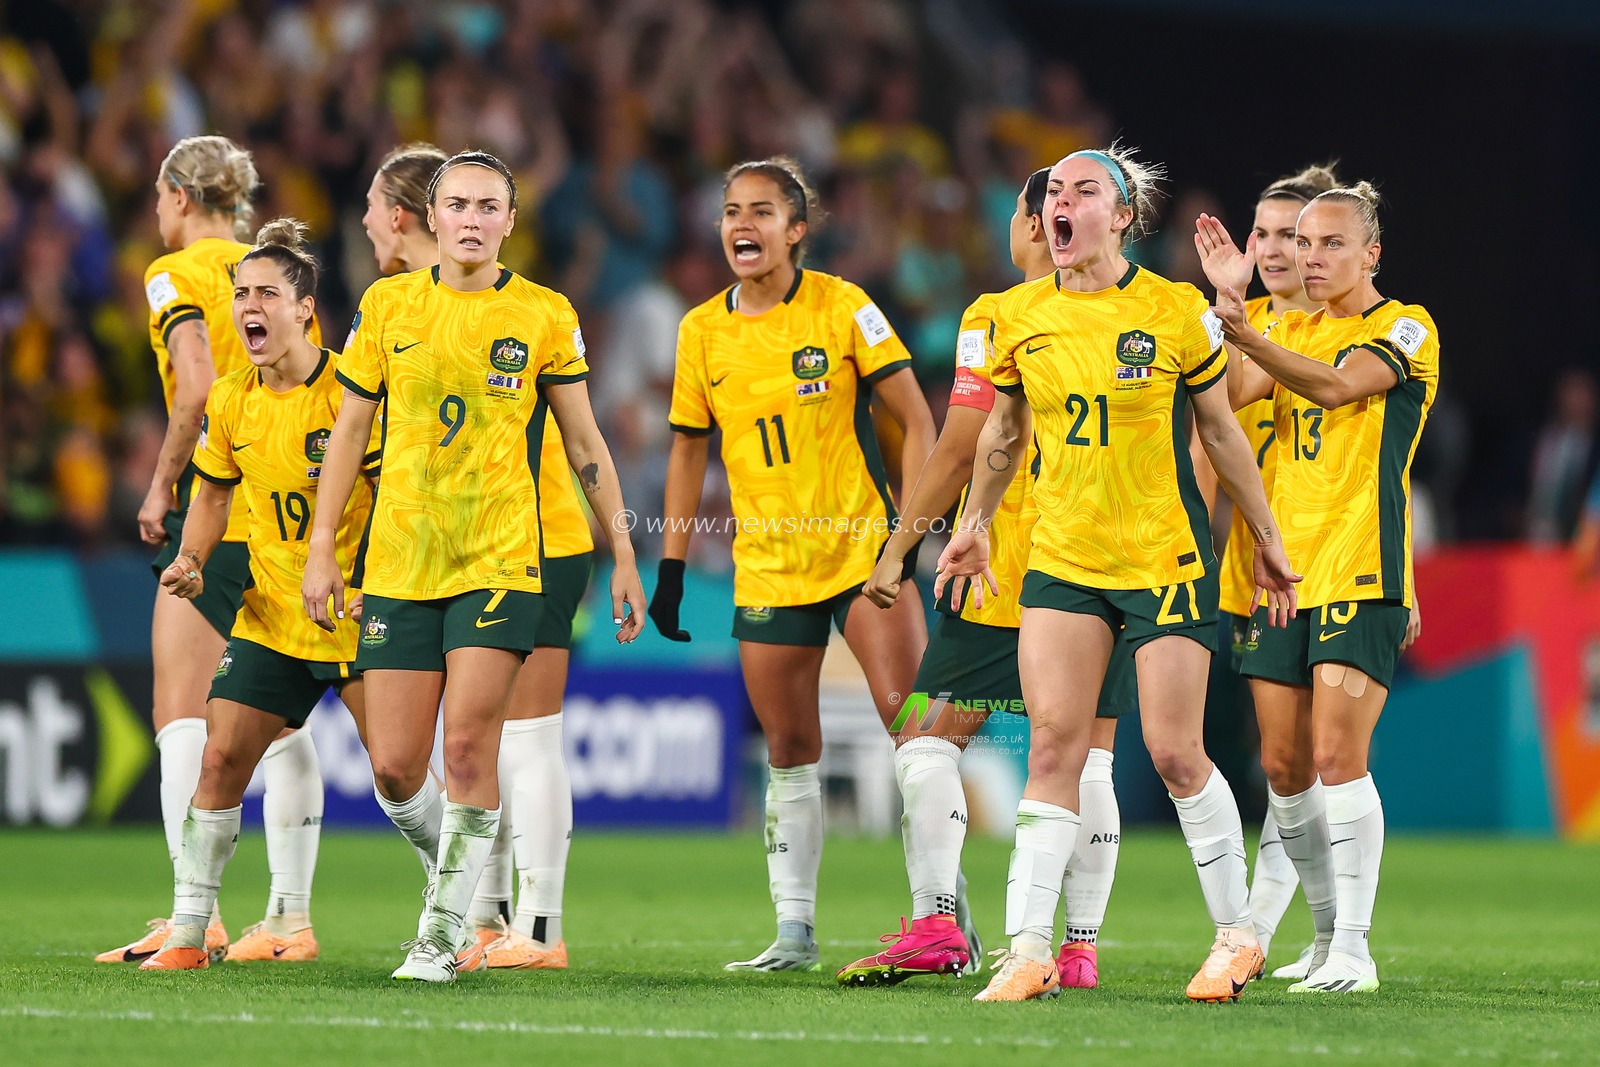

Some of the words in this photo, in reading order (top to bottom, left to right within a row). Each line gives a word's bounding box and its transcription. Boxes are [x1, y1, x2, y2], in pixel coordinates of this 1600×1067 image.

[438, 394, 466, 447] 9
[755, 414, 791, 468] 11
[1065, 393, 1109, 446] 21
[1291, 408, 1323, 461] 13
[270, 491, 311, 541] 19
[767, 842, 788, 854] US
[1090, 833, 1119, 844] AUS
